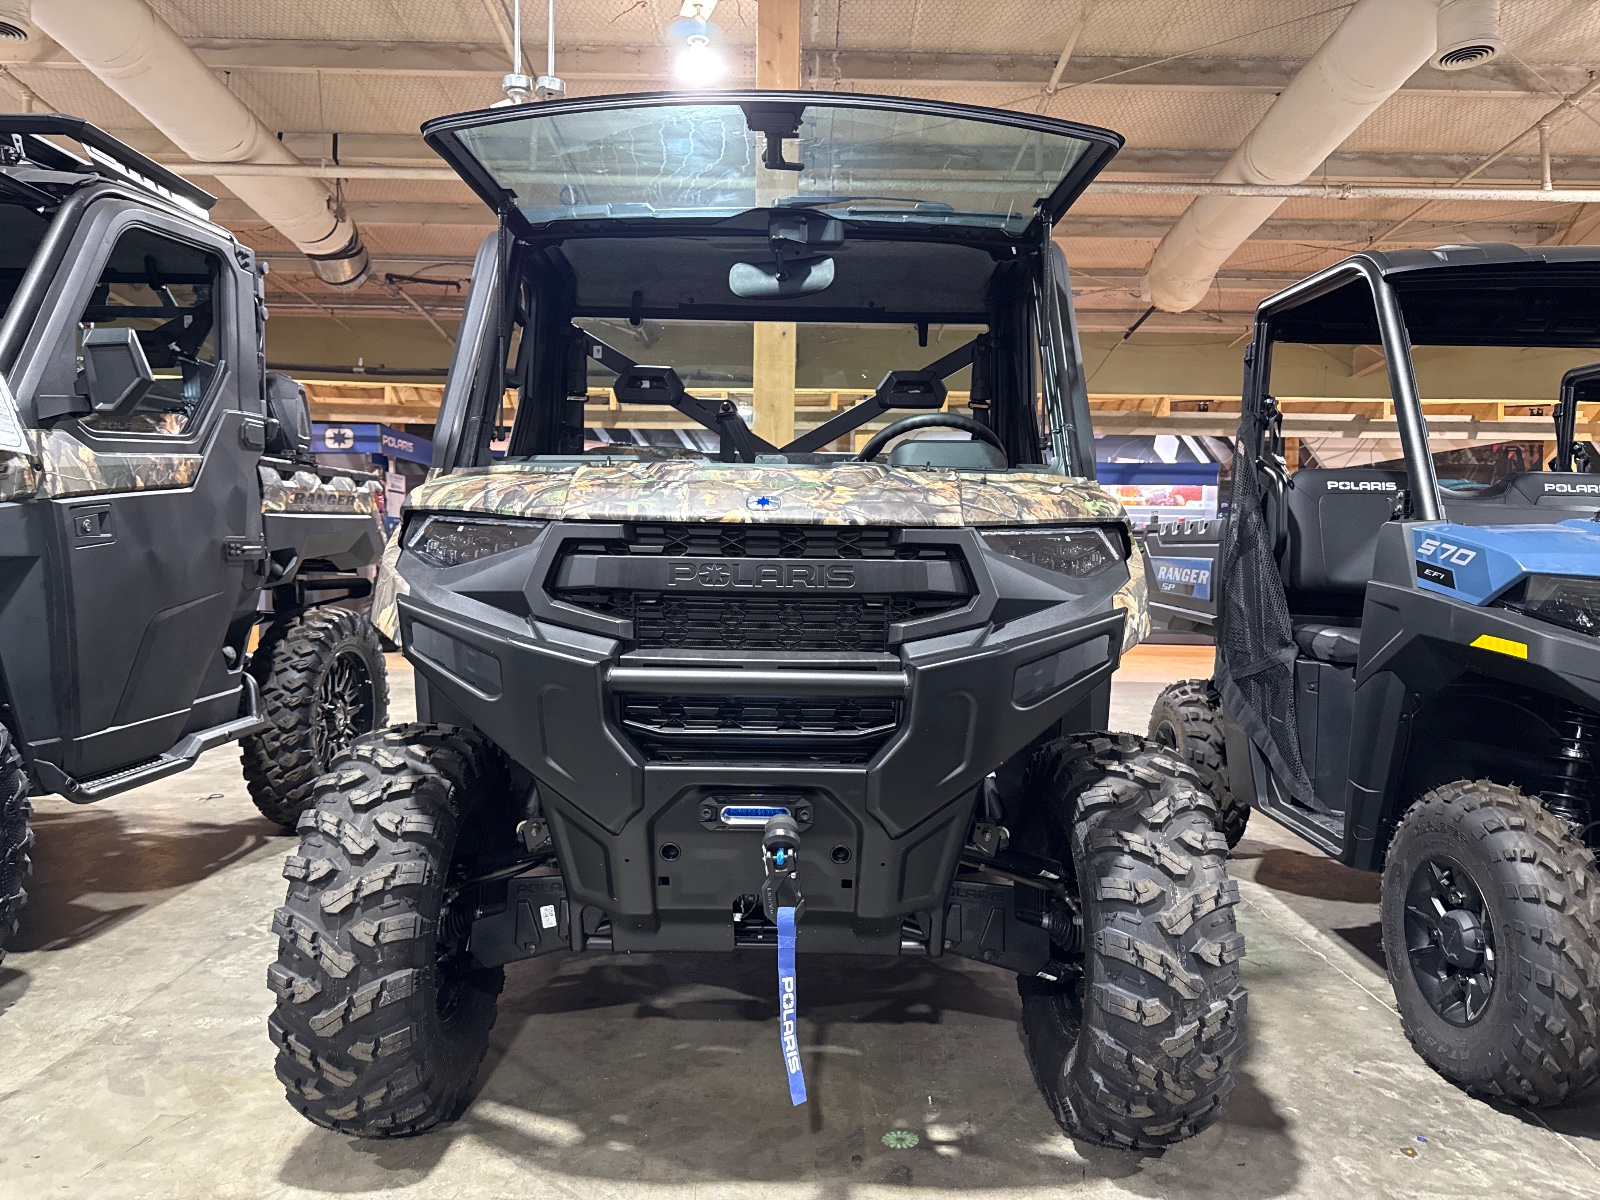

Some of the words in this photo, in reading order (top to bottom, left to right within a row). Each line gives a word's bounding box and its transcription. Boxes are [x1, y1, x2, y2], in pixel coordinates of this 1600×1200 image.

[382, 434, 414, 453] POLARIS
[1327, 481, 1397, 491] POLARIS
[1544, 483, 1600, 494] POLAR
[292, 492, 355, 506] RANGER
[1417, 538, 1477, 566] 570
[667, 562, 857, 589] POLARIS
[1158, 566, 1210, 585] RANGER
[1424, 568, 1445, 580] EFI
[1161, 582, 1176, 591] SP
[781, 976, 800, 1074] POLARIS
